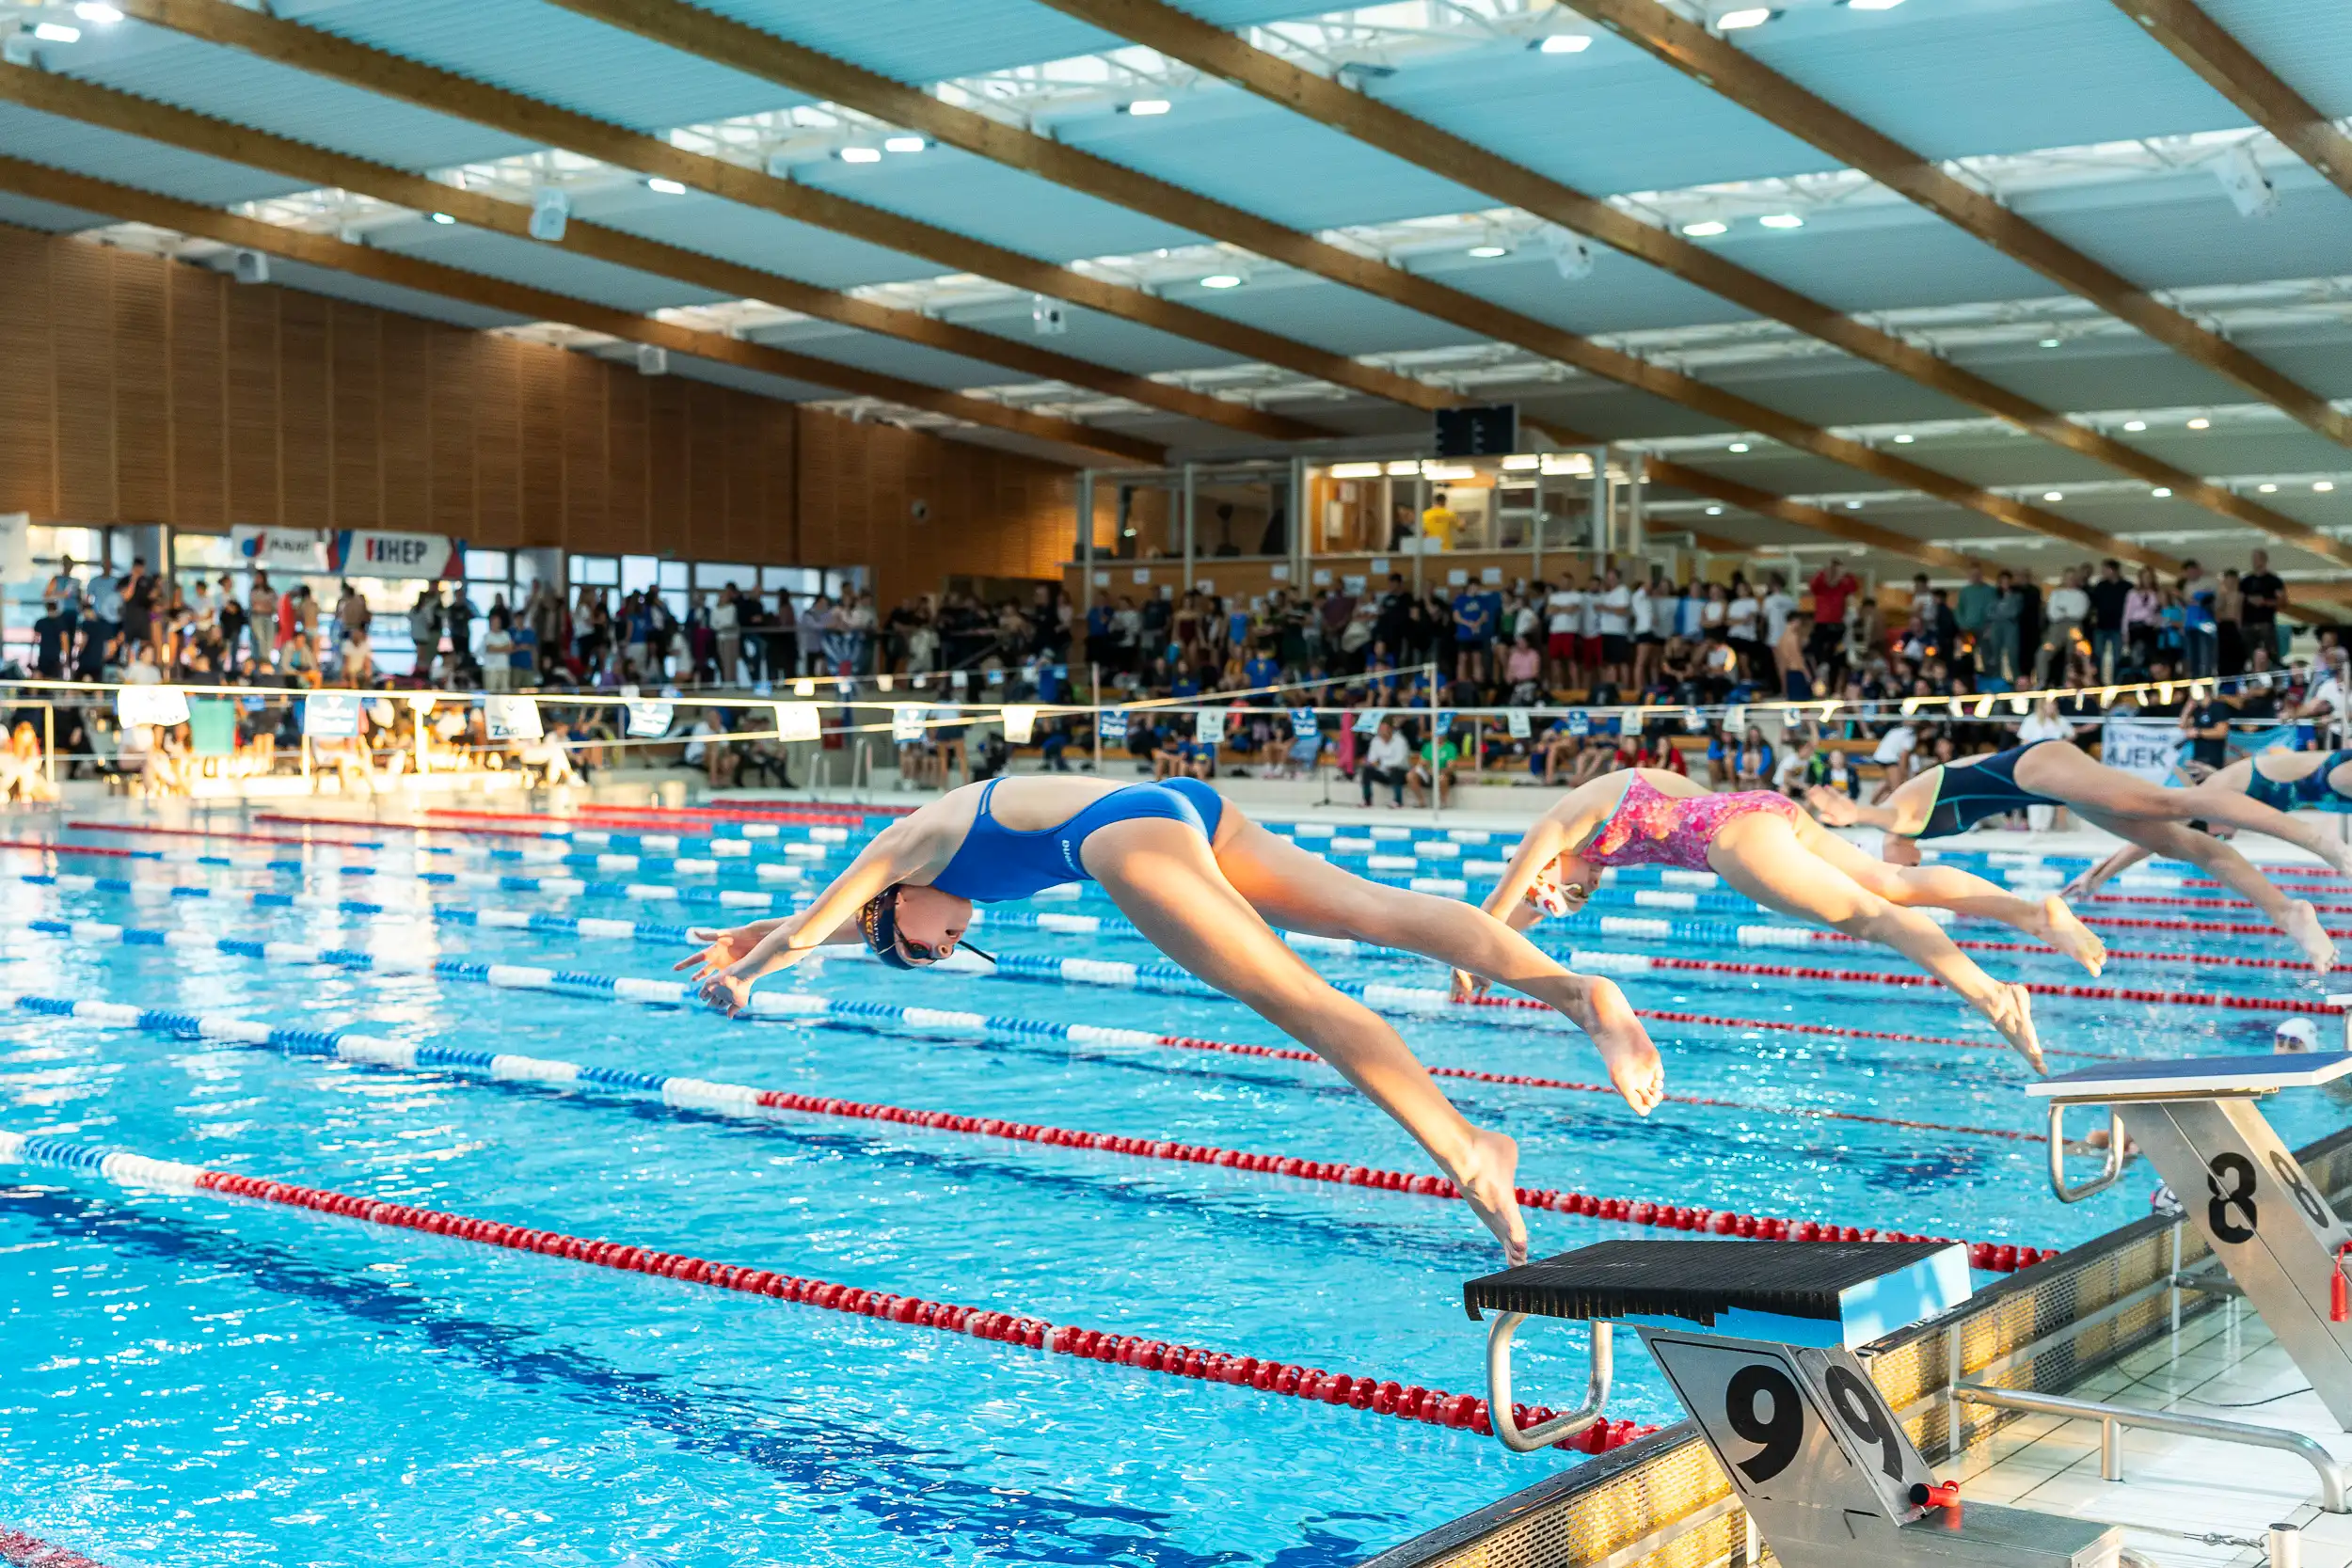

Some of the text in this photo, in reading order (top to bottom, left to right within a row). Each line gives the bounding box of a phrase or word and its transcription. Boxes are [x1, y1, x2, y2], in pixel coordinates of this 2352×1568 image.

[2208, 1152, 2257, 1244] 8
[2269, 1150, 2329, 1228] 8
[1725, 1365, 1804, 1484] 9
[1825, 1366, 1903, 1483] 9
